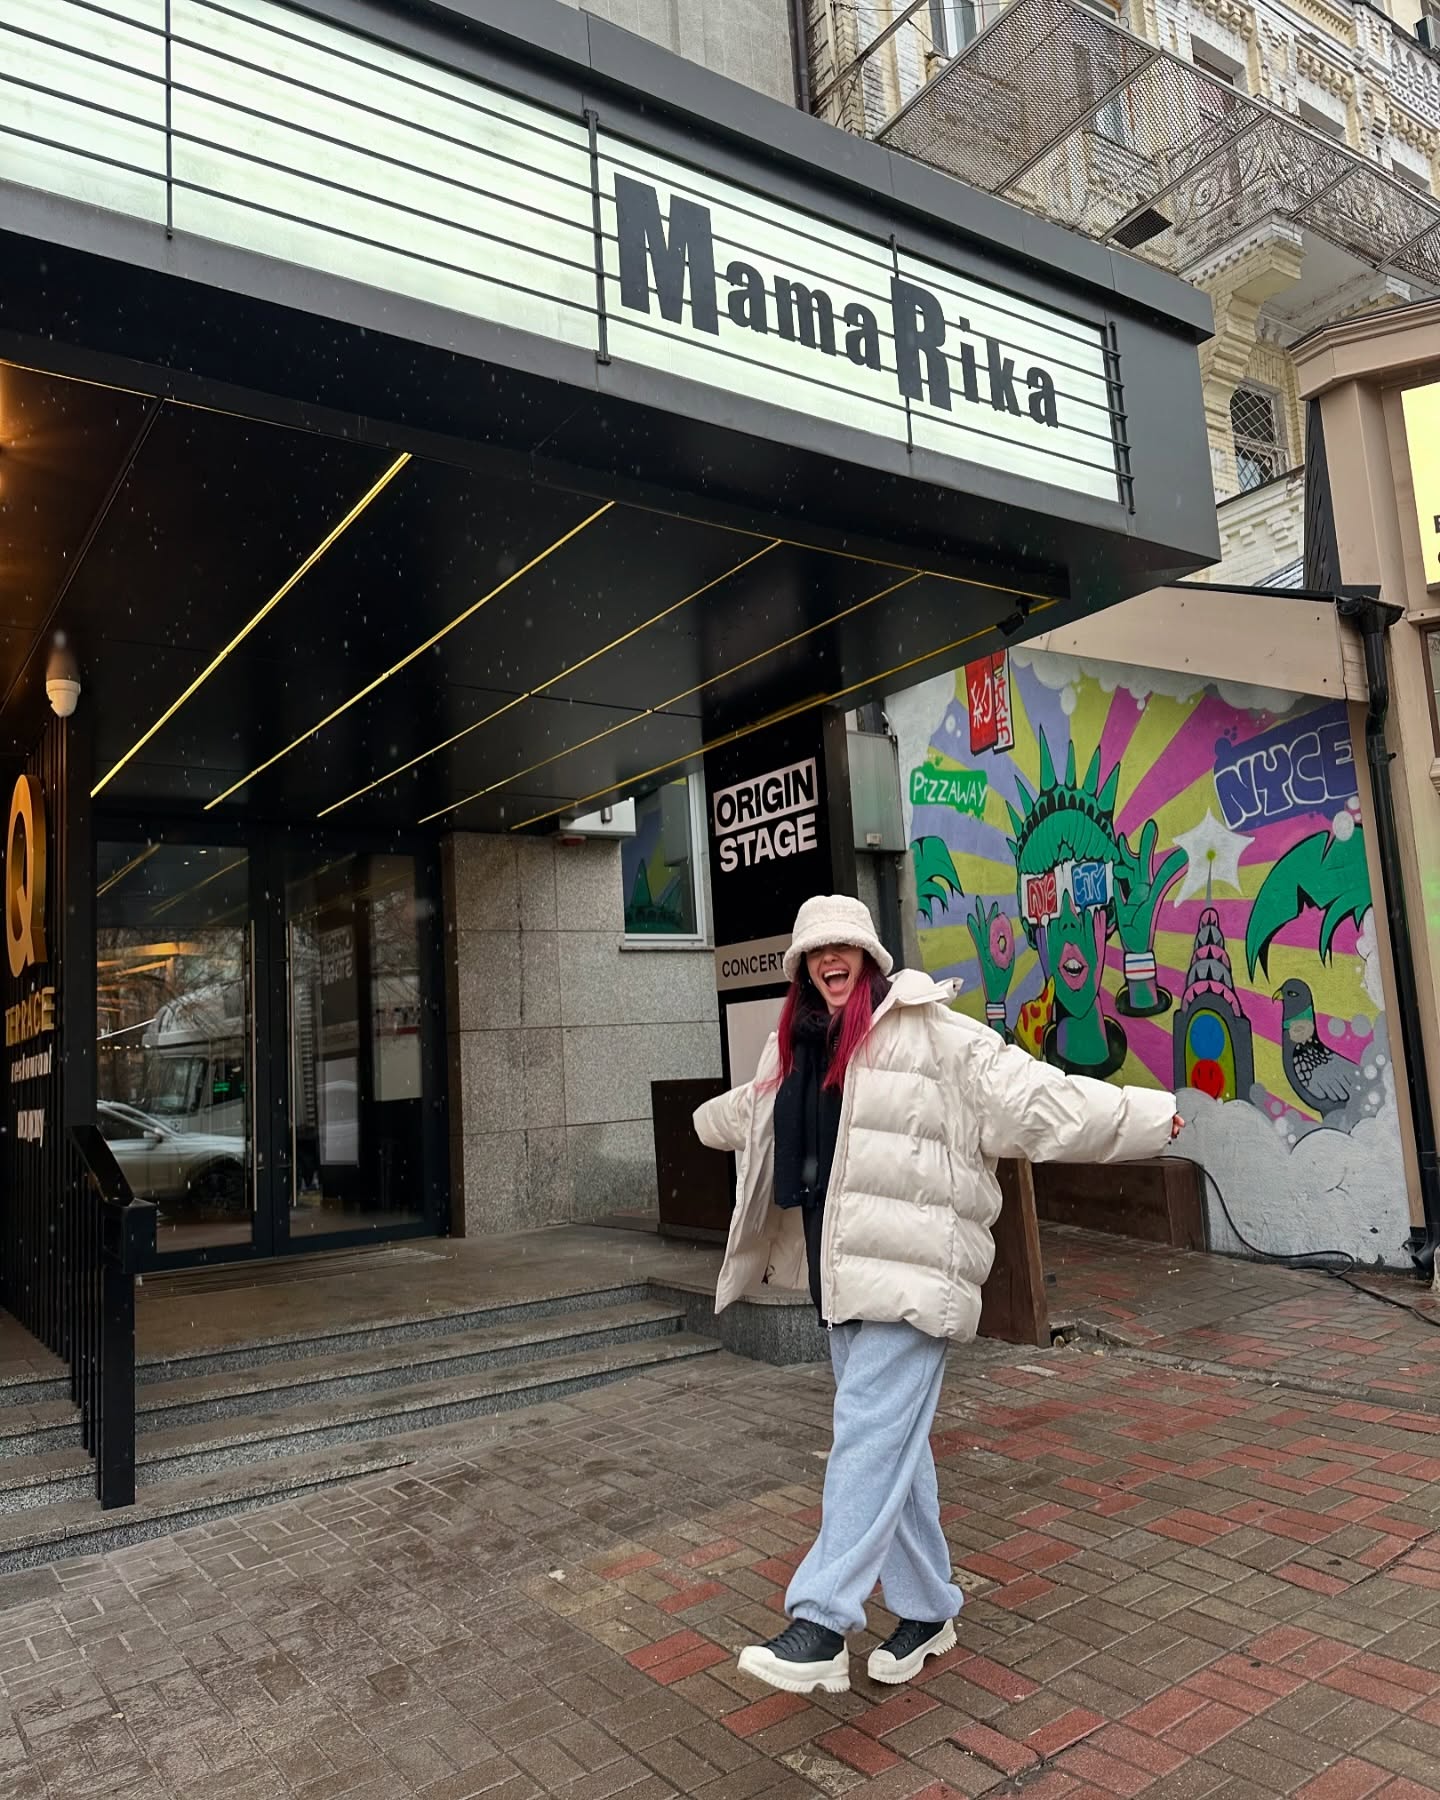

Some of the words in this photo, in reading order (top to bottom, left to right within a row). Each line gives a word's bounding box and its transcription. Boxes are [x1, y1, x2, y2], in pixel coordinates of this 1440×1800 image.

[613, 172, 1059, 429] MamaRika
[716, 764, 815, 829] ORIGIN
[1213, 720, 1359, 830] NYCE
[719, 812, 818, 873] STAGE
[6, 774, 48, 978] Q
[722, 951, 785, 978] CONCERT
[5, 986, 56, 1047] TERRACE
